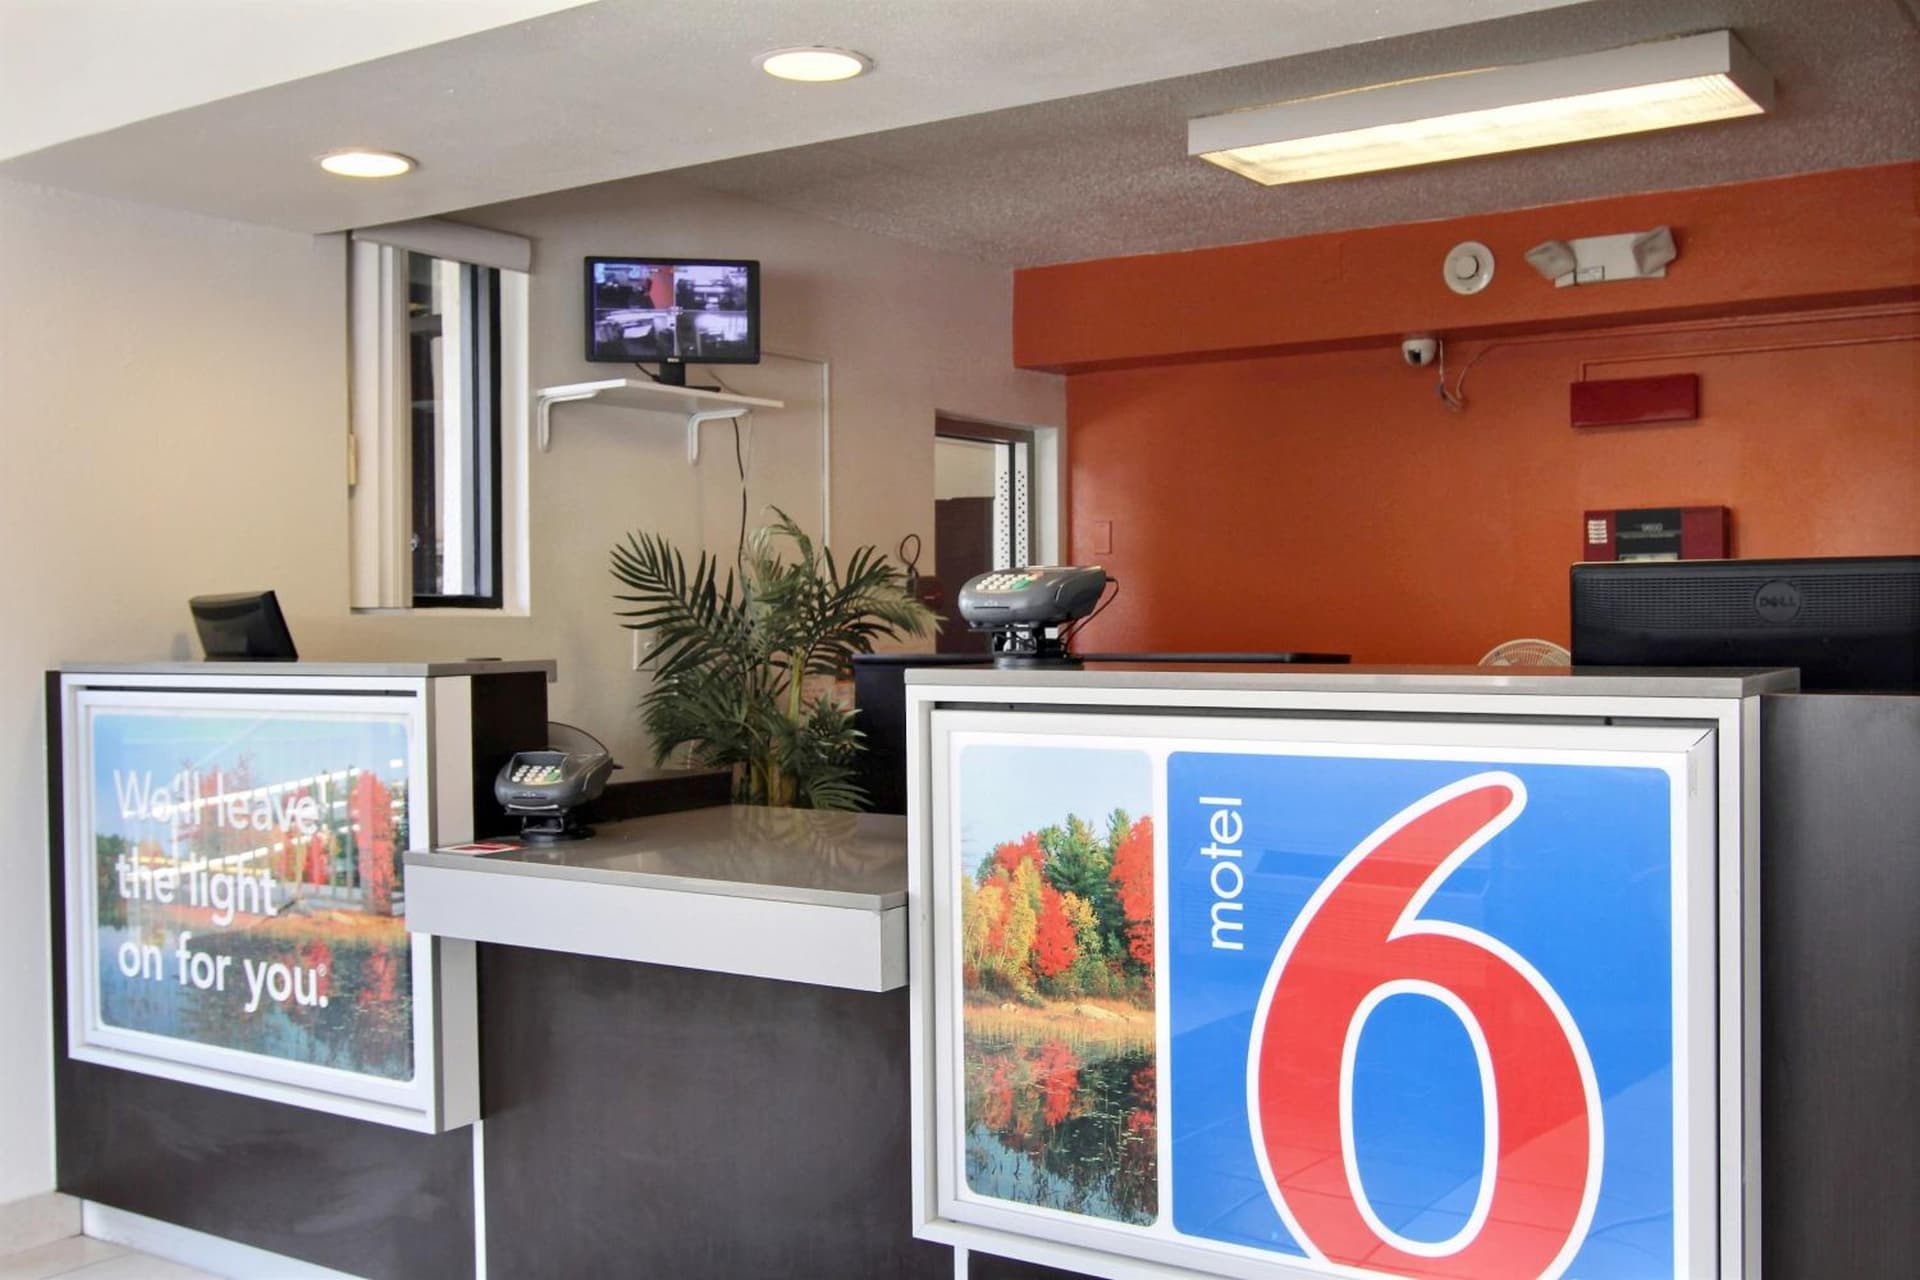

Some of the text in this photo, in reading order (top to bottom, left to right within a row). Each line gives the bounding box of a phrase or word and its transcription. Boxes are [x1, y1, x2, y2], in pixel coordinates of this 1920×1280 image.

[114, 769, 320, 835] We'll leave
[115, 847, 278, 927] the light
[118, 941, 163, 982] on
[176, 931, 232, 991] for
[1200, 771, 1604, 1280] motel 6
